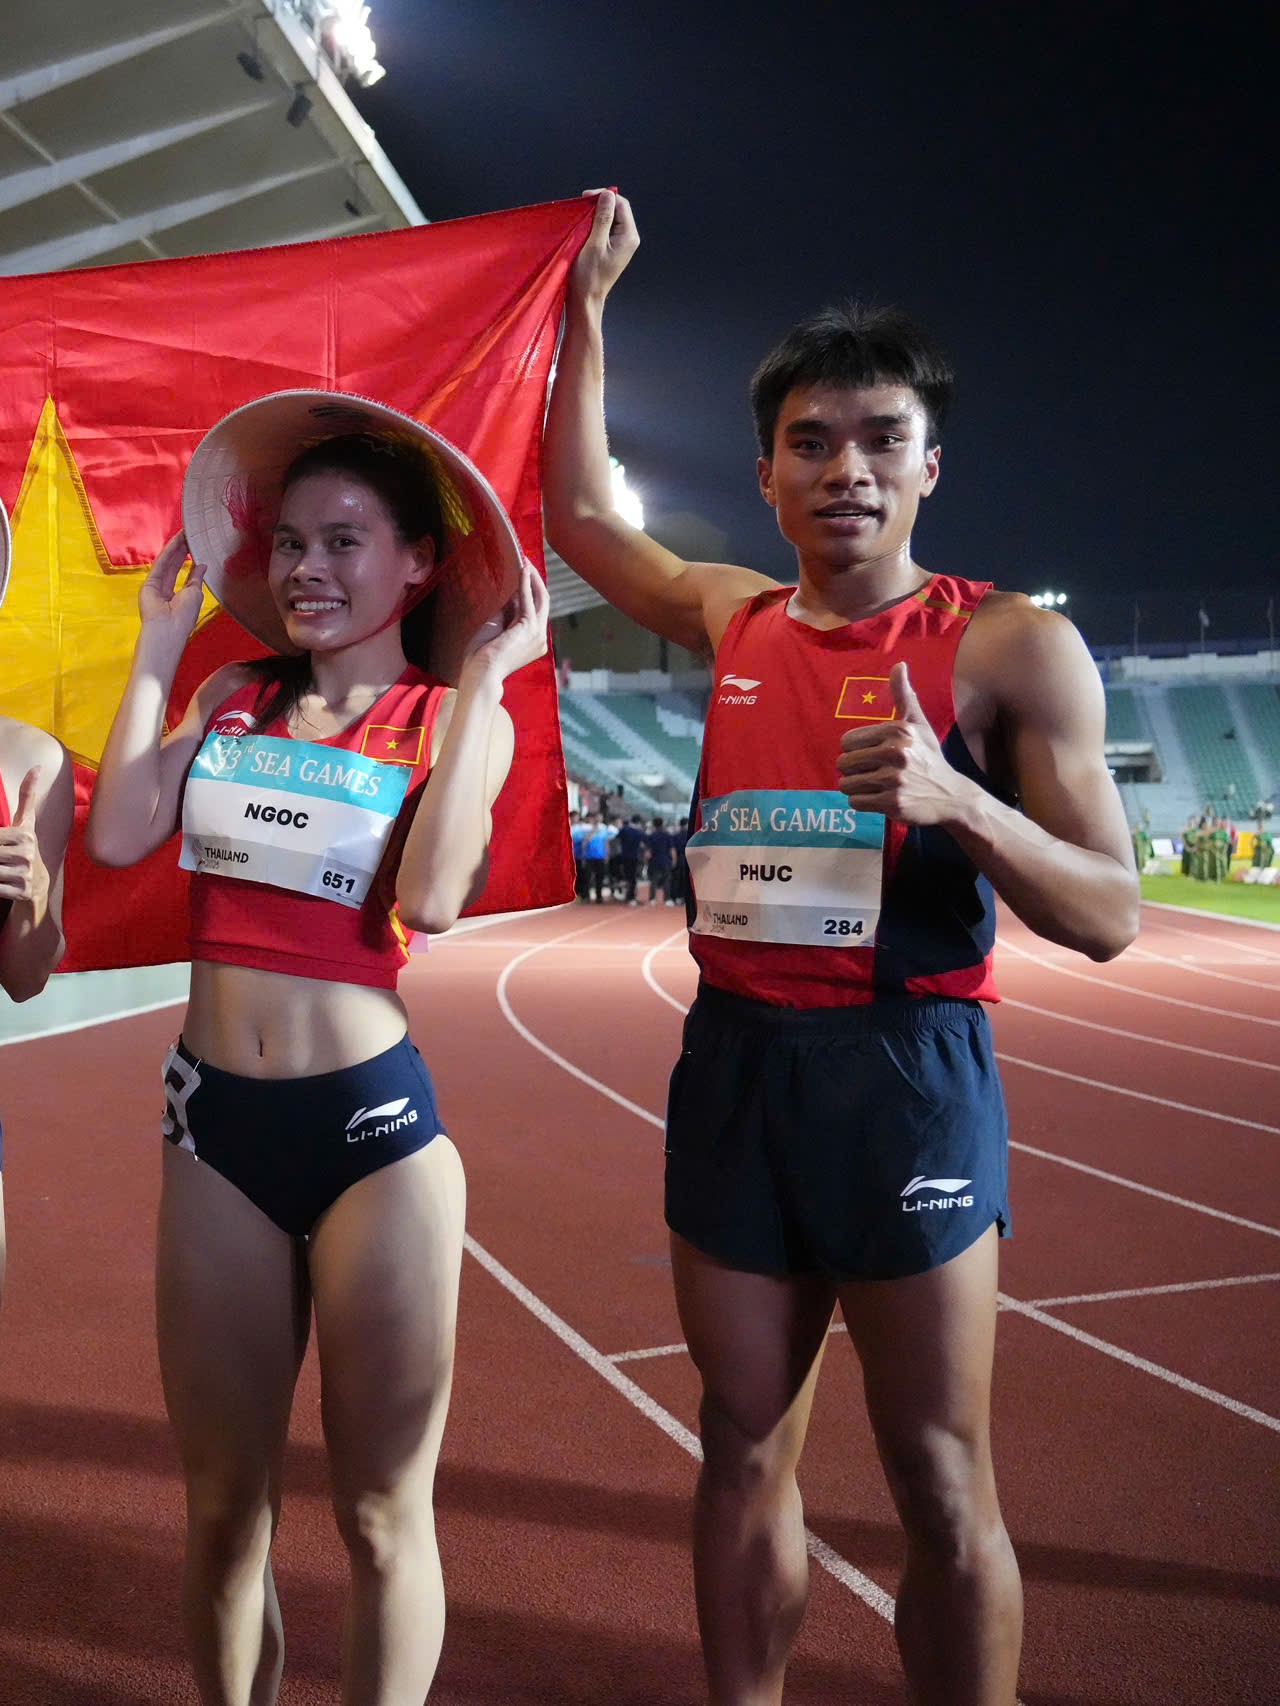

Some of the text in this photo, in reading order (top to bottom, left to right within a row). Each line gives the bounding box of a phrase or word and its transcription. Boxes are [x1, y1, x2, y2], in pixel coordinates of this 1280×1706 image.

[718, 695, 758, 705] I-NING
[250, 750, 291, 777] SEA
[299, 760, 382, 796] GAMES
[244, 802, 309, 829] NGOC
[730, 807, 762, 832] SEA
[771, 809, 857, 834] GAMES
[204, 847, 249, 864] THAILAND
[322, 870, 356, 893] 651
[740, 864, 793, 883] PHUC
[713, 913, 748, 926] THAILAND
[824, 919, 863, 936] 284
[346, 1109, 418, 1143] LI-NING
[902, 1195, 974, 1212] LI-NING
